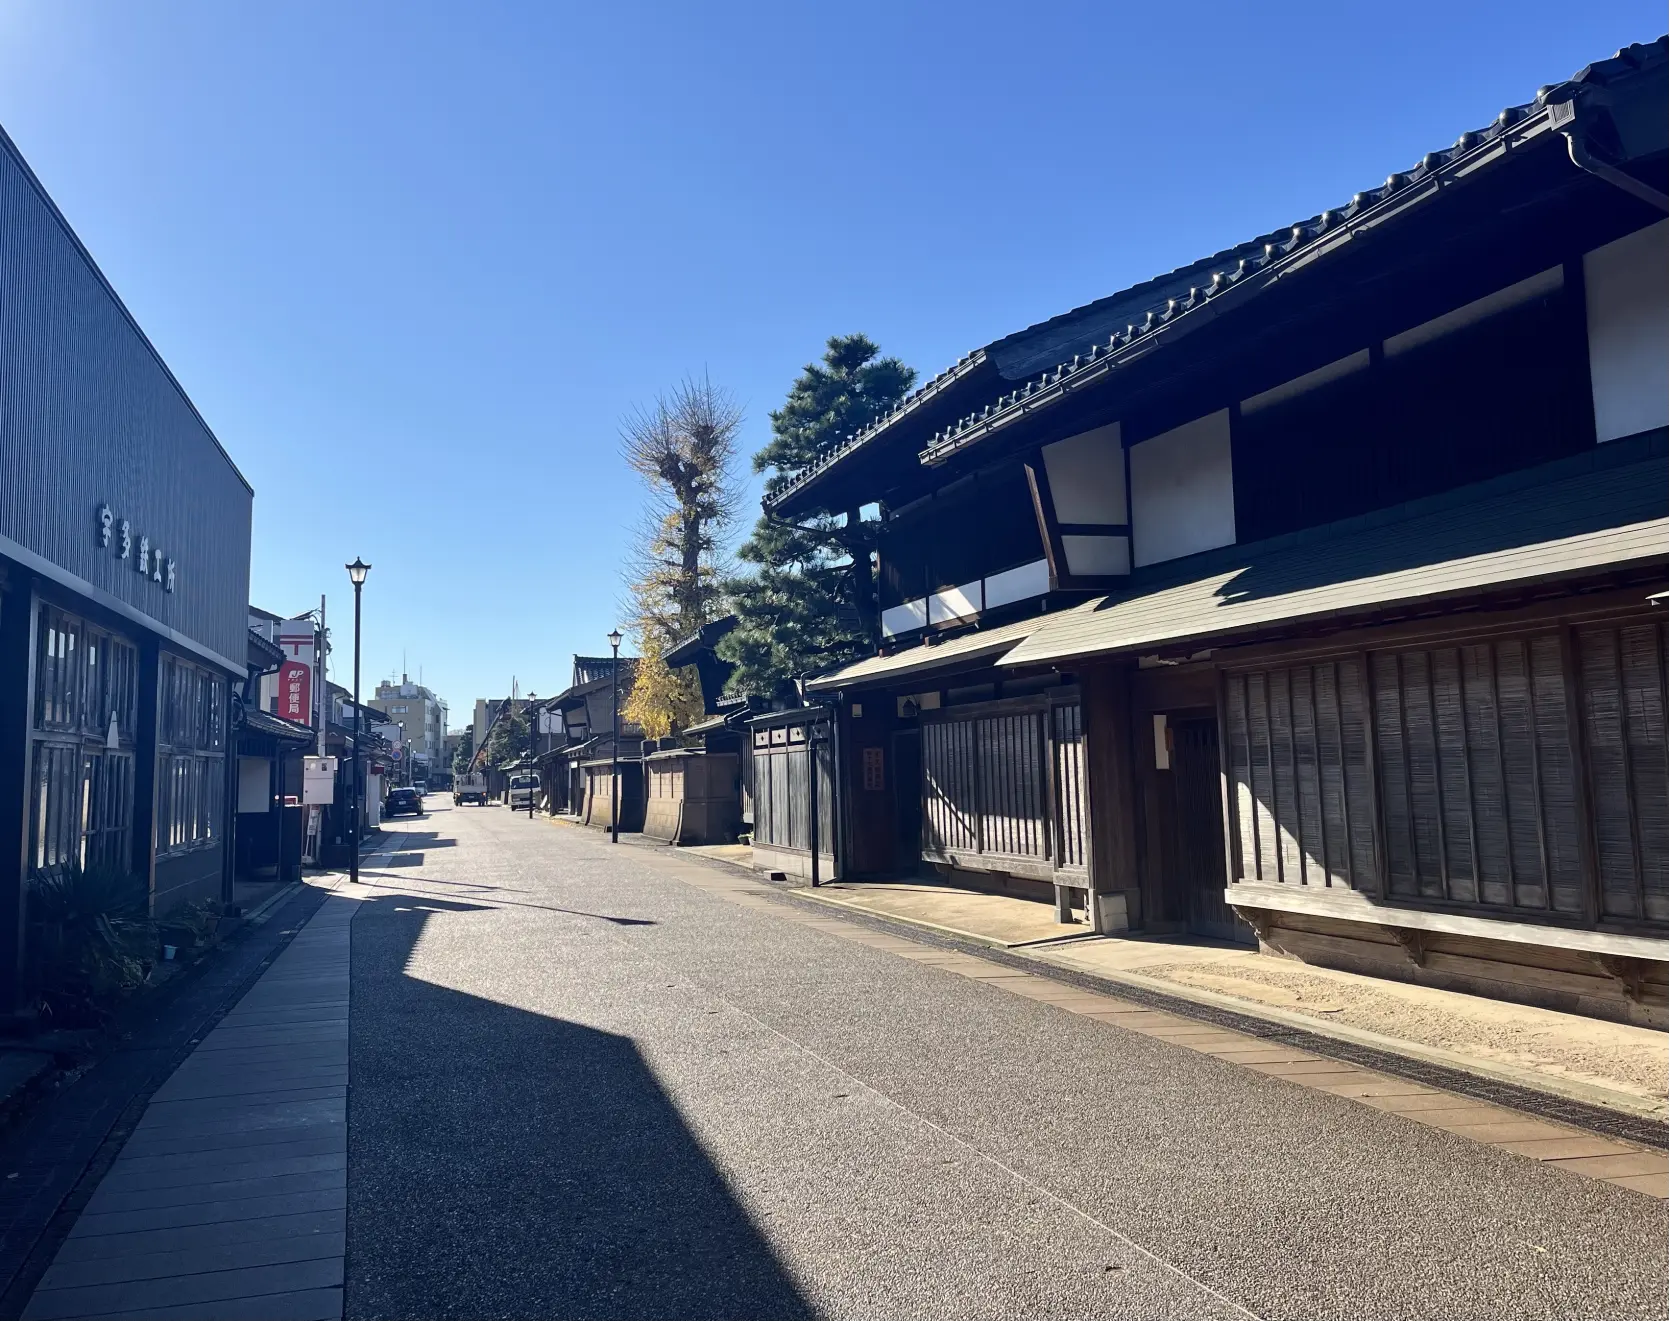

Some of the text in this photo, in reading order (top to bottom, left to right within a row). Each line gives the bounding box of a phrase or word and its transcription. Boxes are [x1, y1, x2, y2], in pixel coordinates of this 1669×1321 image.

[288, 670, 304, 679] JP
[288, 682, 301, 714] 郵便局
